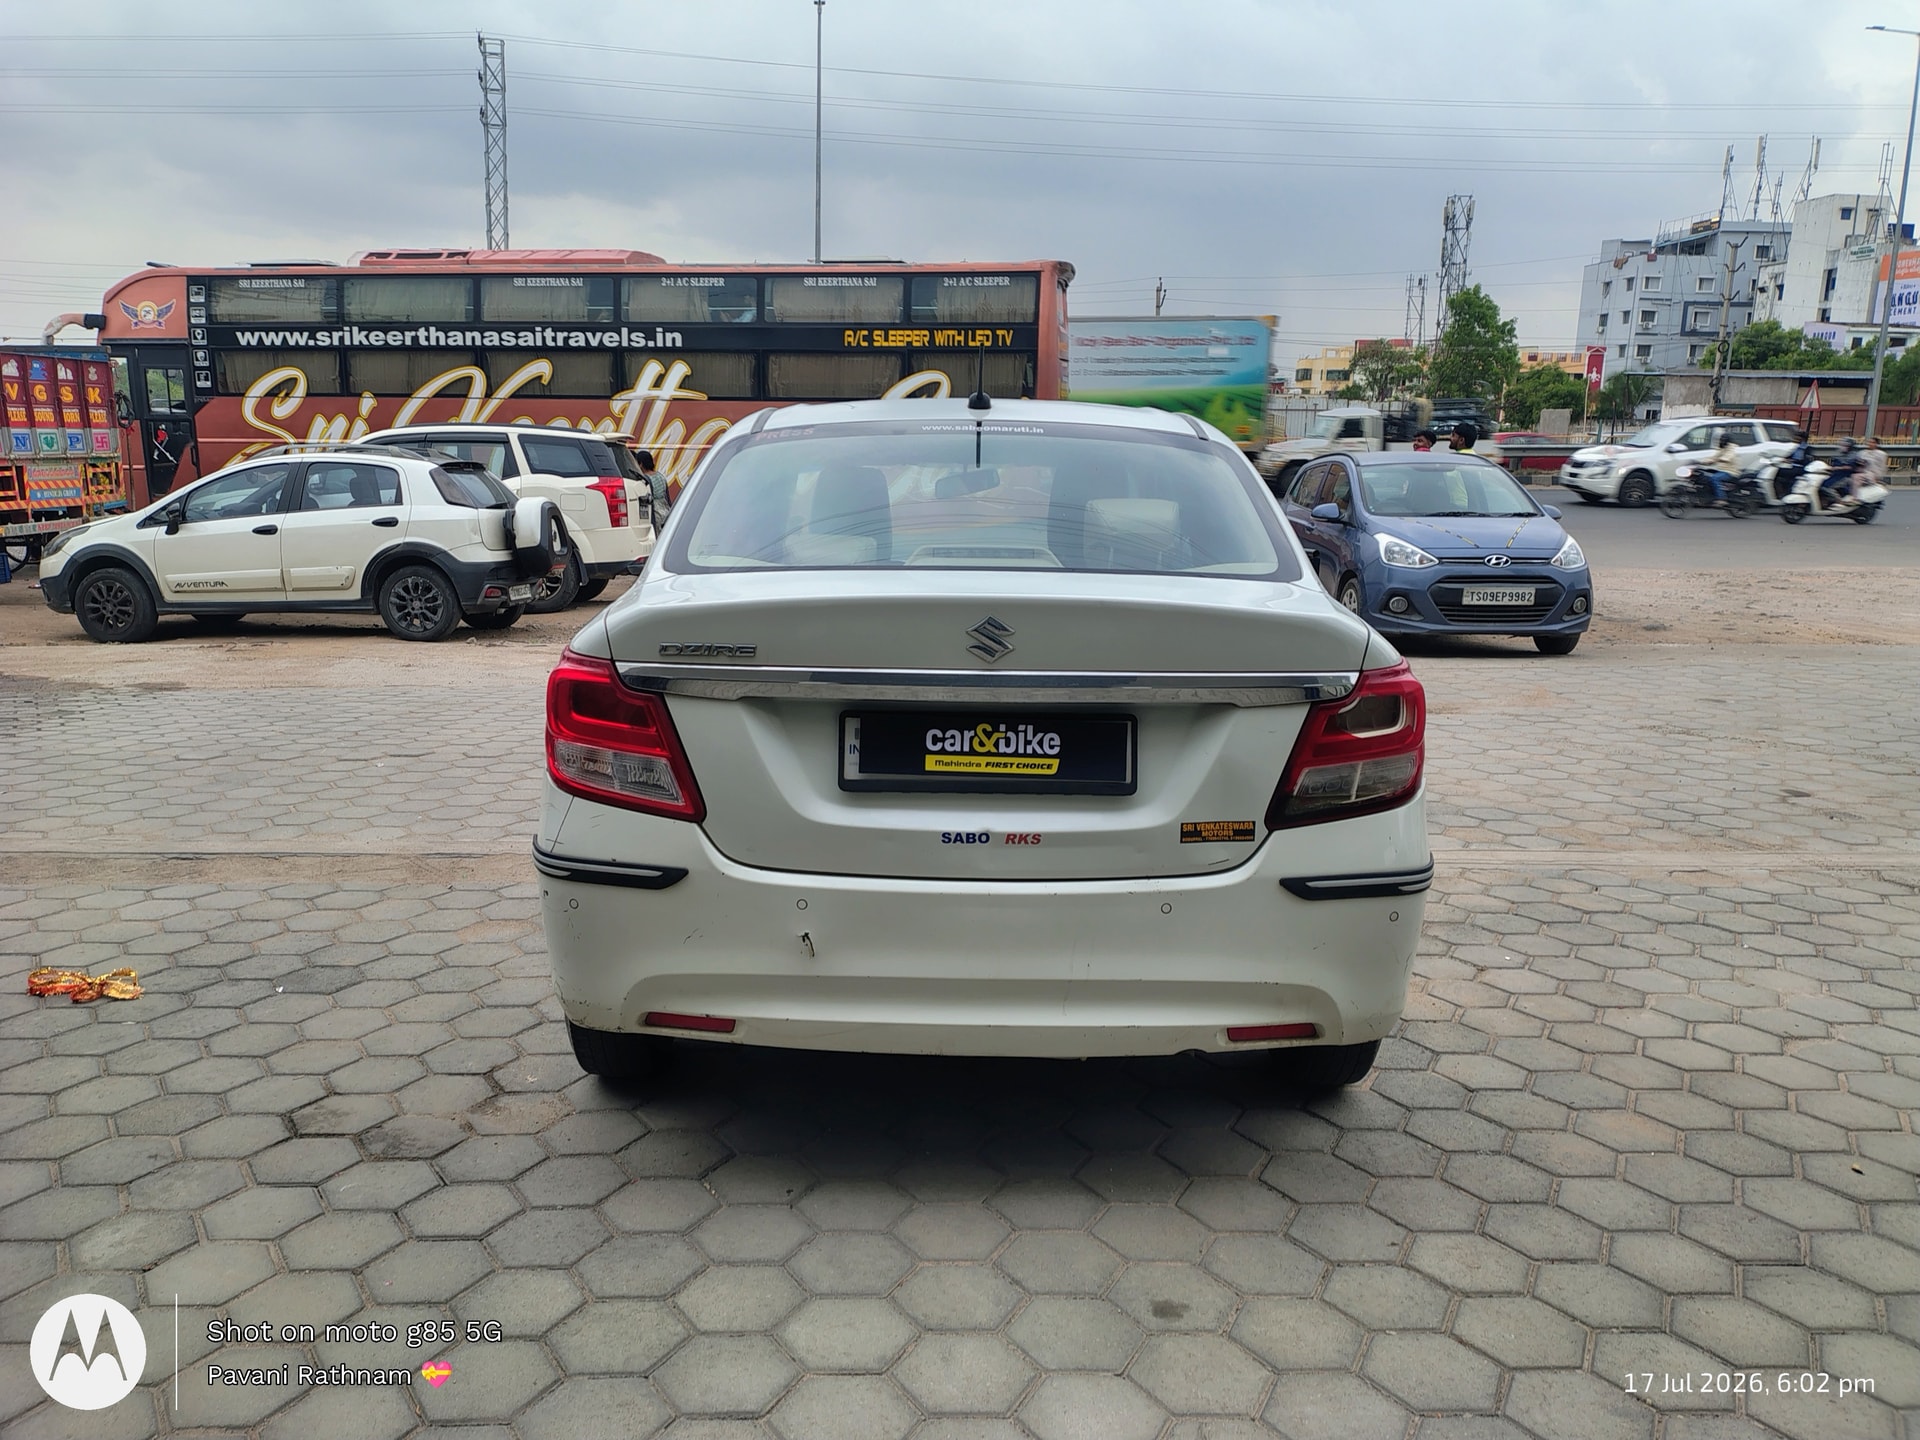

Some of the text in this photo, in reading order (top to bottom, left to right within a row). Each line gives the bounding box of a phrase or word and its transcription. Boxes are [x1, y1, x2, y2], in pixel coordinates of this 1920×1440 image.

[239, 279, 305, 288] SRI KEERTHANA SAI
[513, 278, 583, 287] SRI KEERTHANA SAI
[690, 277, 725, 287] SLEEPER
[804, 277, 877, 287] SRI KEERTHANA SAI
[974, 276, 1010, 287] SLEEPER
[236, 326, 683, 347] www.srikeerthanasaitravels.in
[844, 329, 1013, 347] A/C SLEEPER WITH LED TV
[33, 384, 47, 401] G
[60, 386, 74, 403] S
[87, 387, 102, 404] K
[754, 427, 815, 441] PRESS
[174, 580, 229, 589] AVVENTURA
[1470, 591, 1533, 602] TS09EP9982
[659, 643, 757, 657] DZIRE
[925, 723, 1061, 755] car&bike
[934, 759, 1053, 770] Mahindra FIRST CHOICE
[1182, 822, 1254, 832] SRI VENKATESWARA
[941, 832, 1042, 845] SABO RKS
